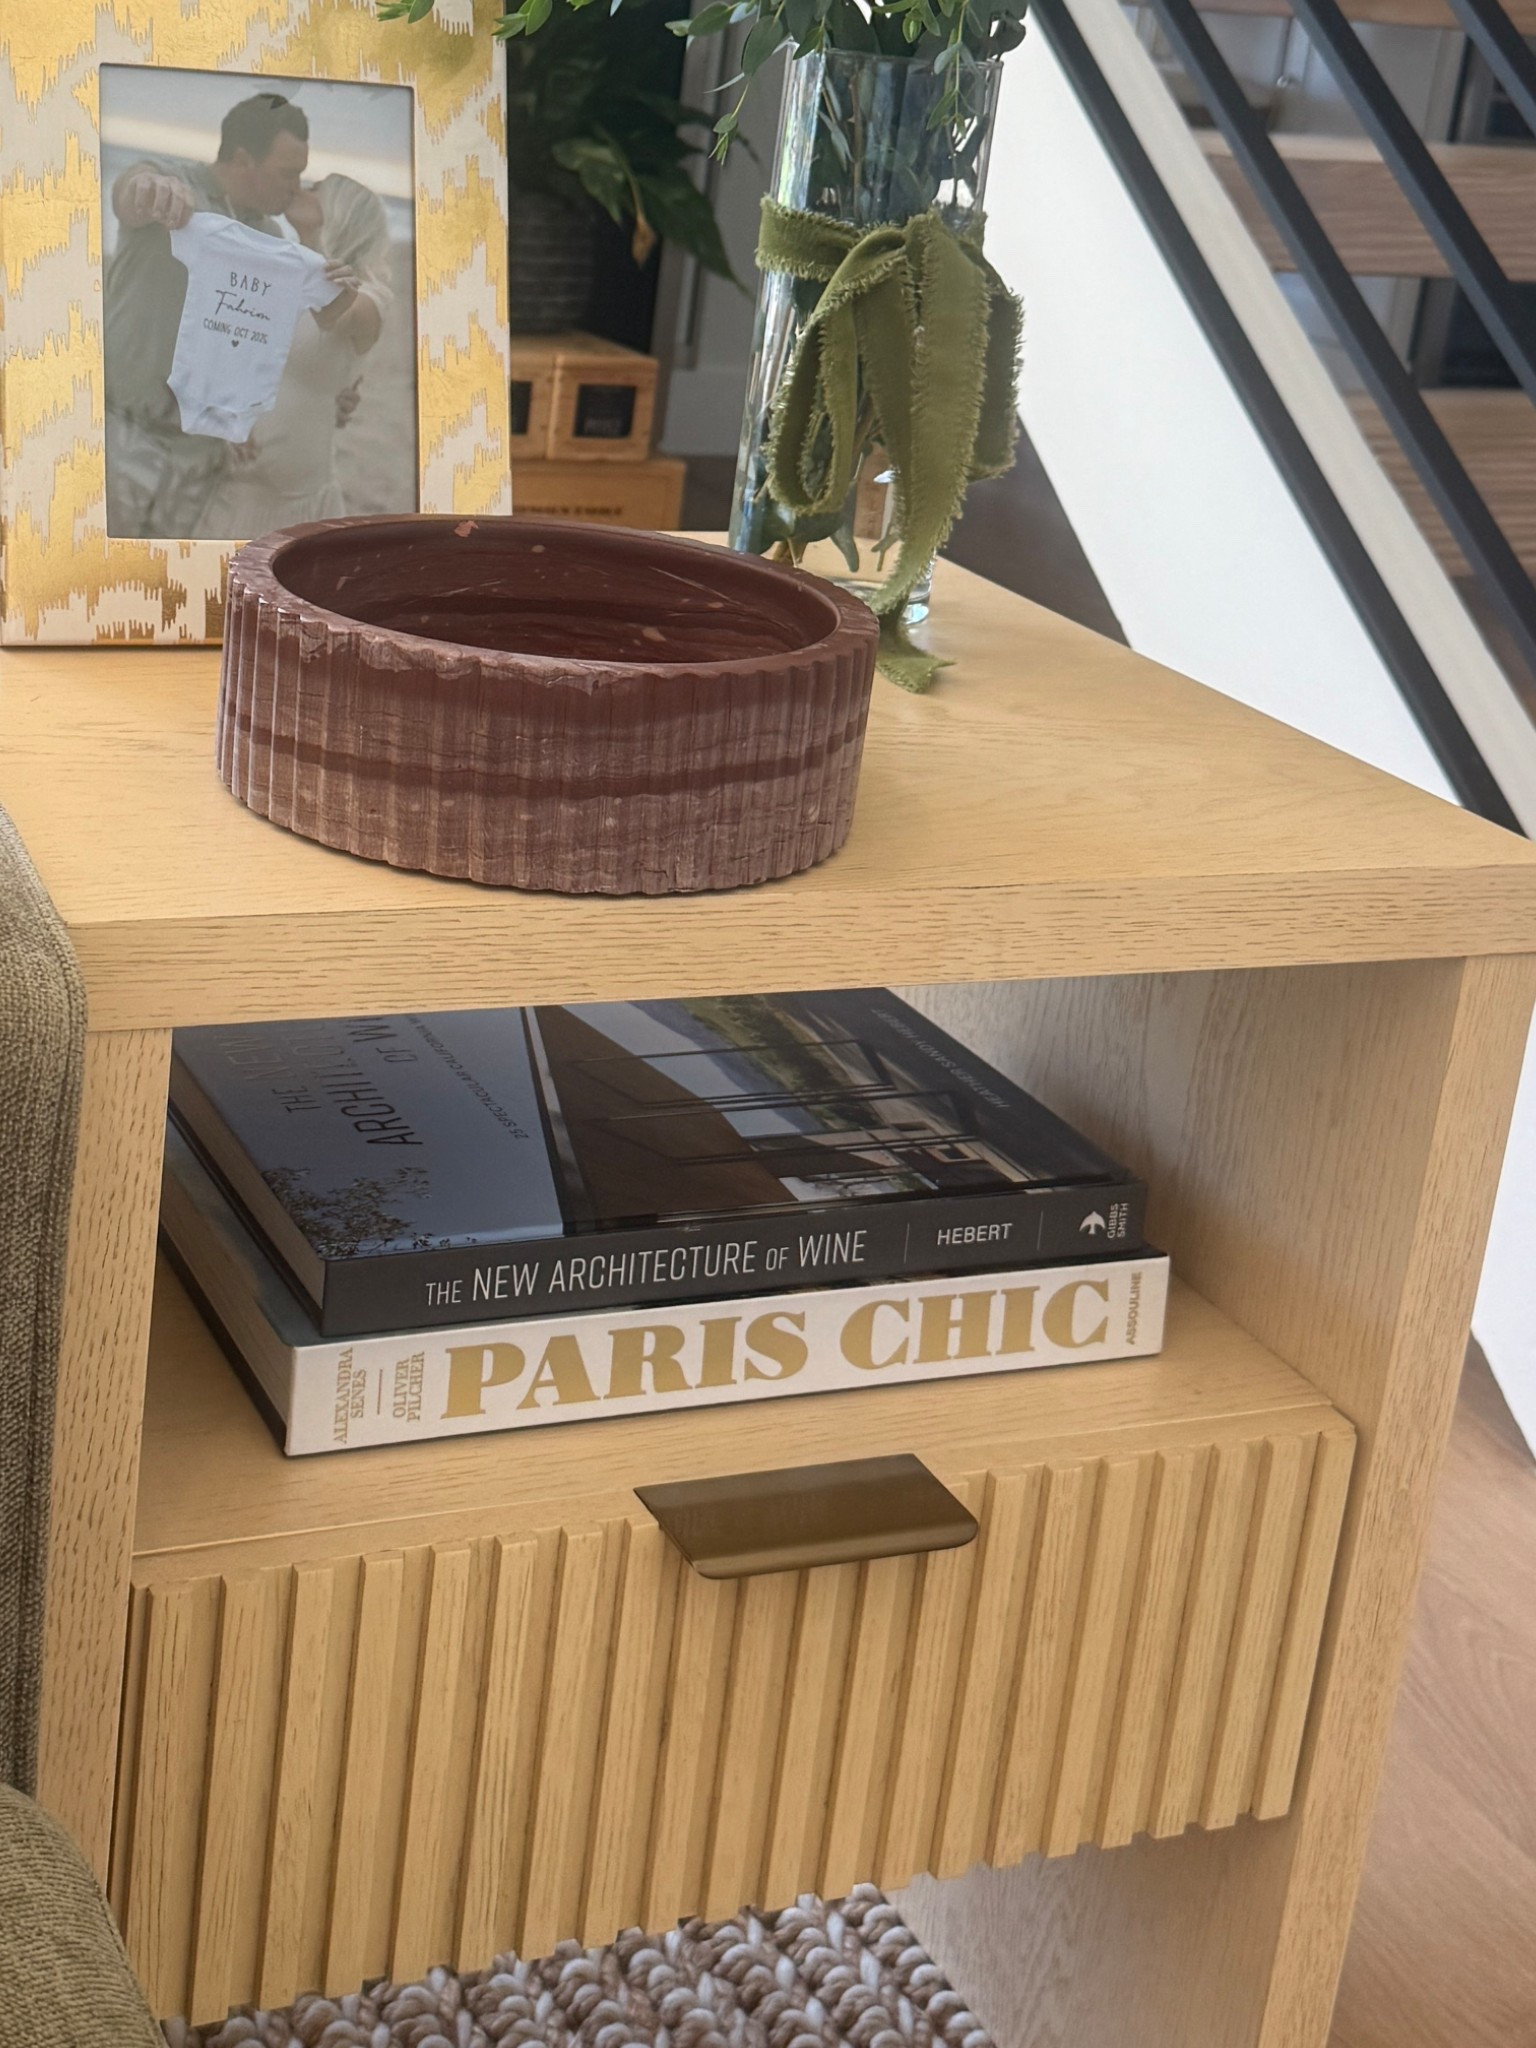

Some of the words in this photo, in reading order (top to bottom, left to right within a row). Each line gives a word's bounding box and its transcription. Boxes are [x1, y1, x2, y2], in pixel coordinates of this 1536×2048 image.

[230, 271, 272, 297] BABY
[203, 317, 231, 335] COMING
[234, 326, 249, 339] OCT
[345, 1016, 398, 1043] WI
[375, 1047, 418, 1063] OF
[271, 1085, 322, 1114] THE
[508, 1127, 530, 1139] 25
[936, 1222, 1013, 1246] HEBERT
[1107, 1202, 1119, 1239] GIBBS
[1116, 1202, 1130, 1238] SMITH
[425, 1279, 463, 1306] THE
[472, 1261, 540, 1301] NEW
[548, 1240, 758, 1294] ARCHITECTURE
[764, 1246, 790, 1271] OF
[799, 1229, 868, 1268] WINE
[1125, 1271, 1143, 1346] ASSOULINE
[439, 1310, 809, 1420] PARIS
[840, 1279, 1110, 1371] CHIC
[332, 1346, 354, 1445] ALEXANDRA
[391, 1358, 410, 1420] OLIVER
[406, 1350, 426, 1423] PILCHER
